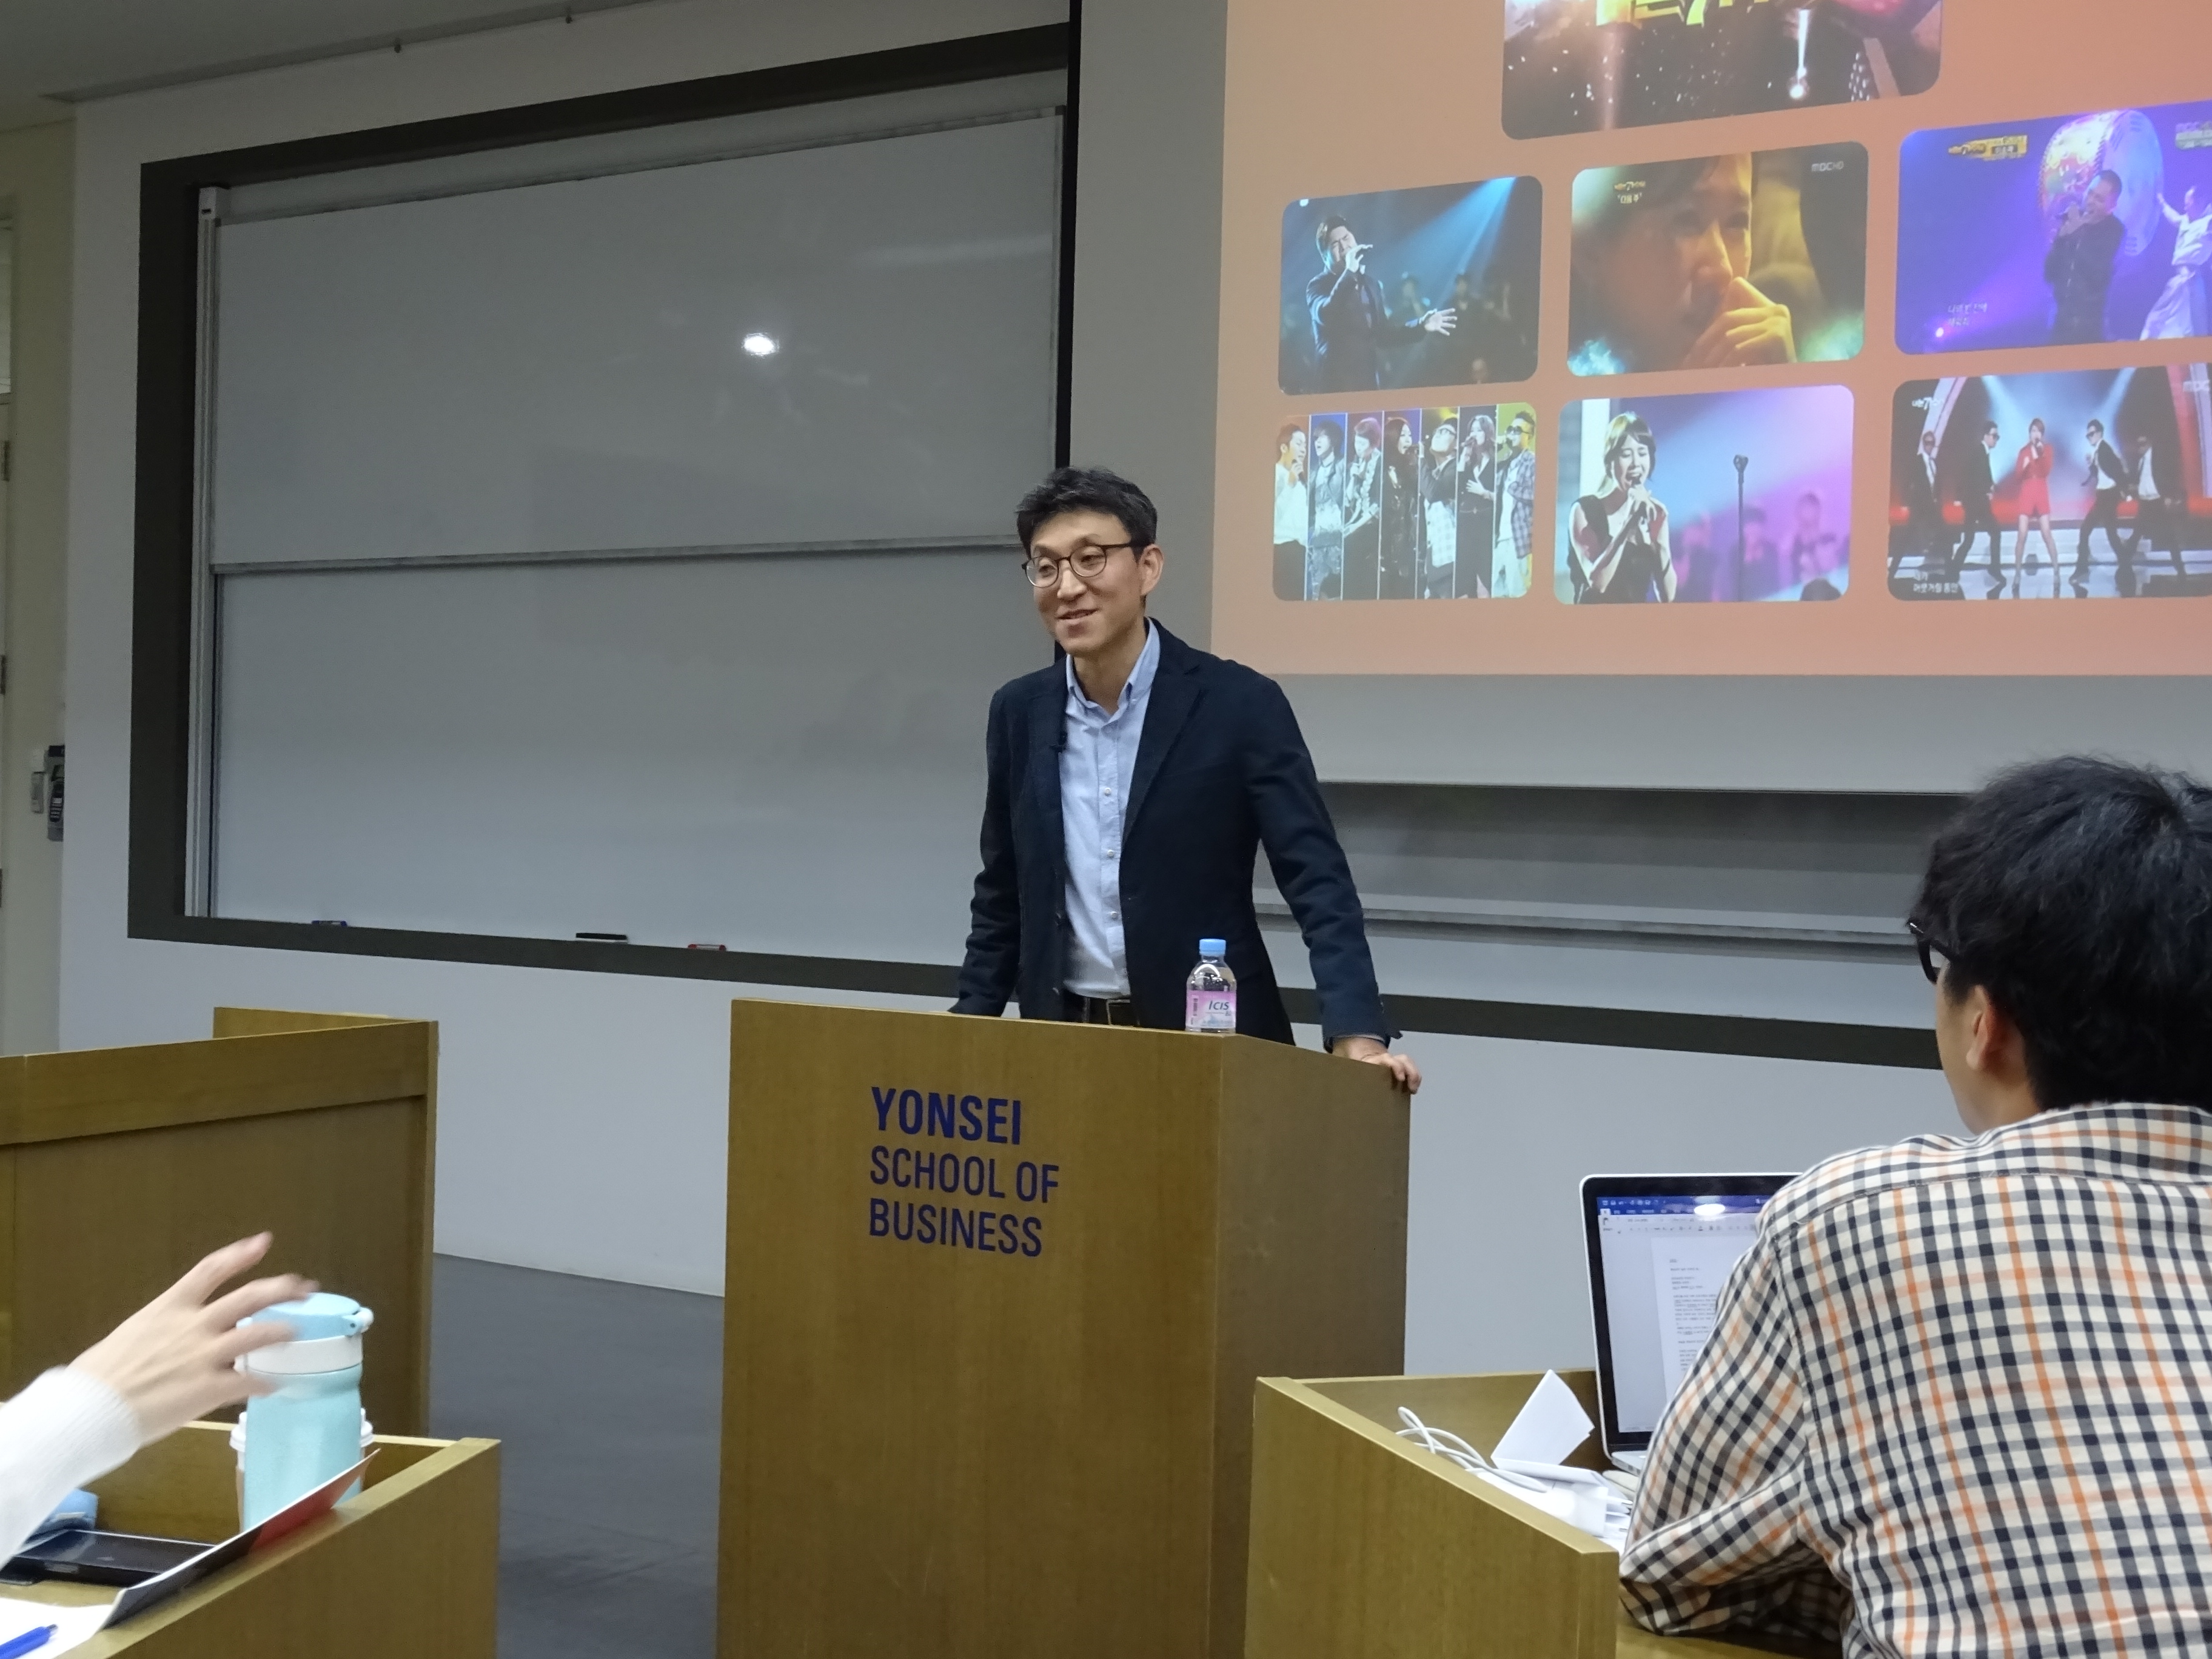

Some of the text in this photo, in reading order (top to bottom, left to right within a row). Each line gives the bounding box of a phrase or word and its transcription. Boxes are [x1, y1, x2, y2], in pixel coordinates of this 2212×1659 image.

[871, 1087, 1021, 1145] YONSEI
[870, 1145, 1059, 1203] SCHOOL OF
[870, 1198, 1042, 1258] BUSINESS
